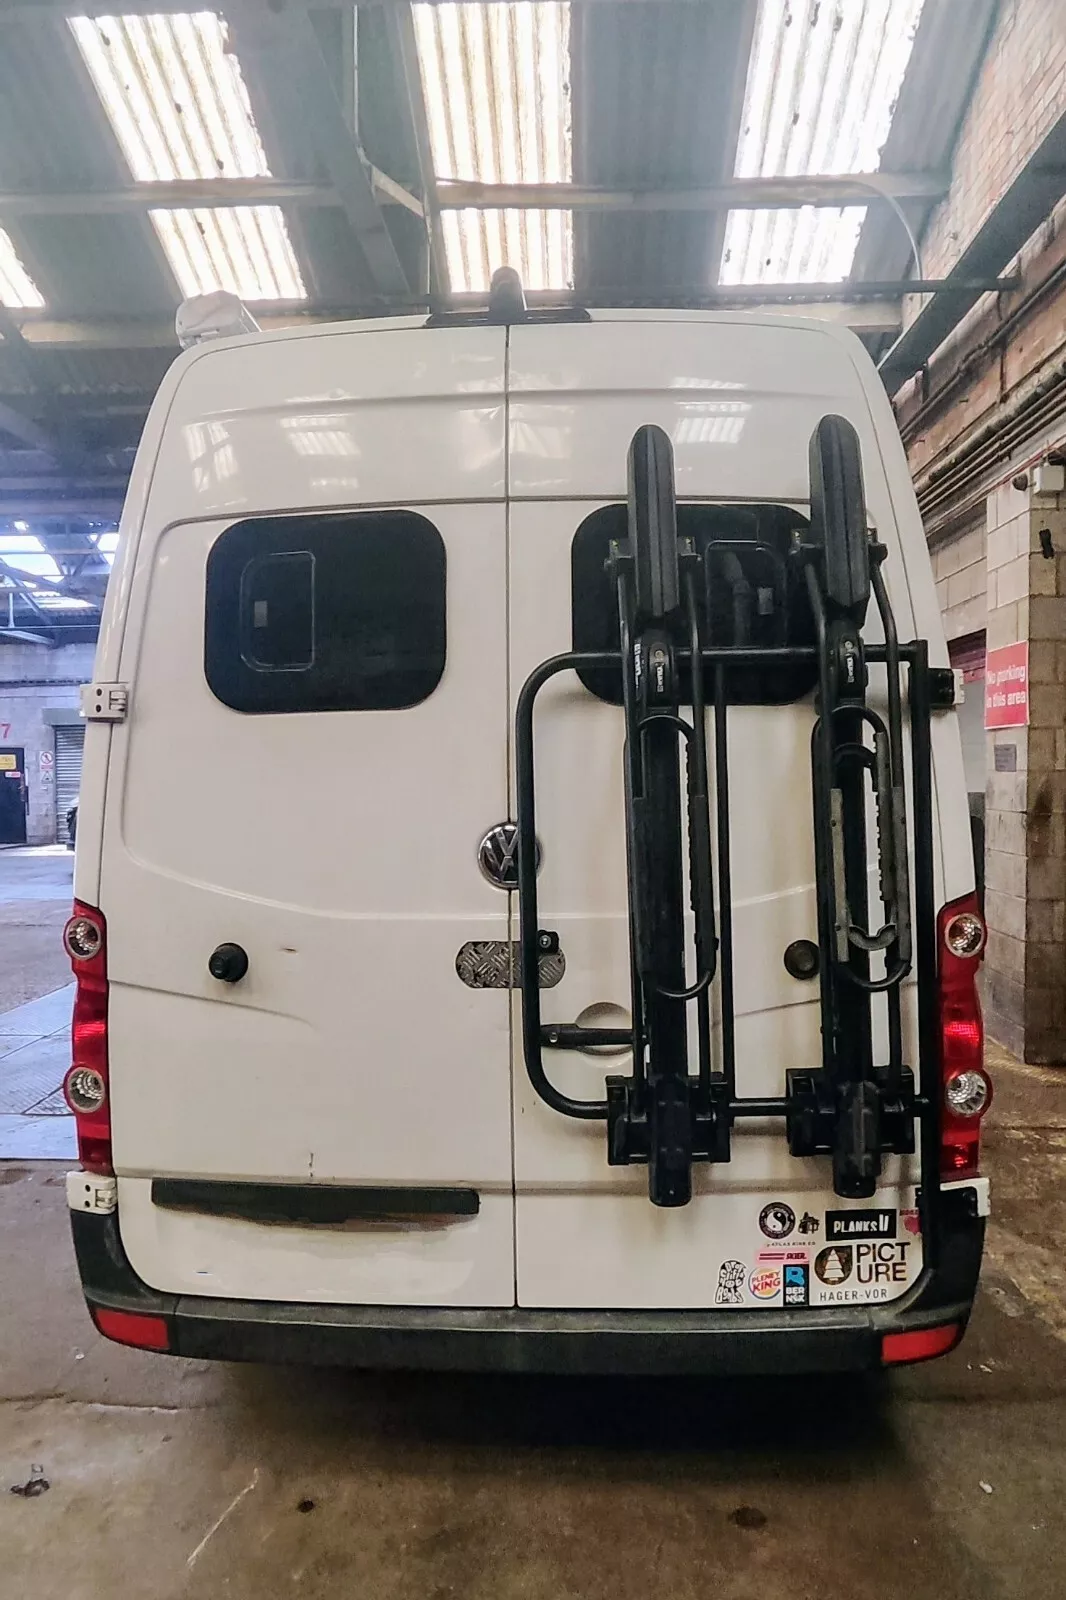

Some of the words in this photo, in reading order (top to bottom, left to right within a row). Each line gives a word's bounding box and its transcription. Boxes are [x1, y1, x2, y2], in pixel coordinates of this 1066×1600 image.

[997, 665, 1026, 687] parking
[993, 691, 1006, 707] this
[1008, 691, 1026, 706] area
[1, 723, 11, 739] 7
[833, 1219, 878, 1233] PLANKS
[856, 1242, 911, 1263] PICT
[857, 1262, 907, 1284] URE
[752, 1278, 781, 1292] KING
[785, 1286, 805, 1295] BER
[820, 1288, 888, 1301] HAGER-VOR
